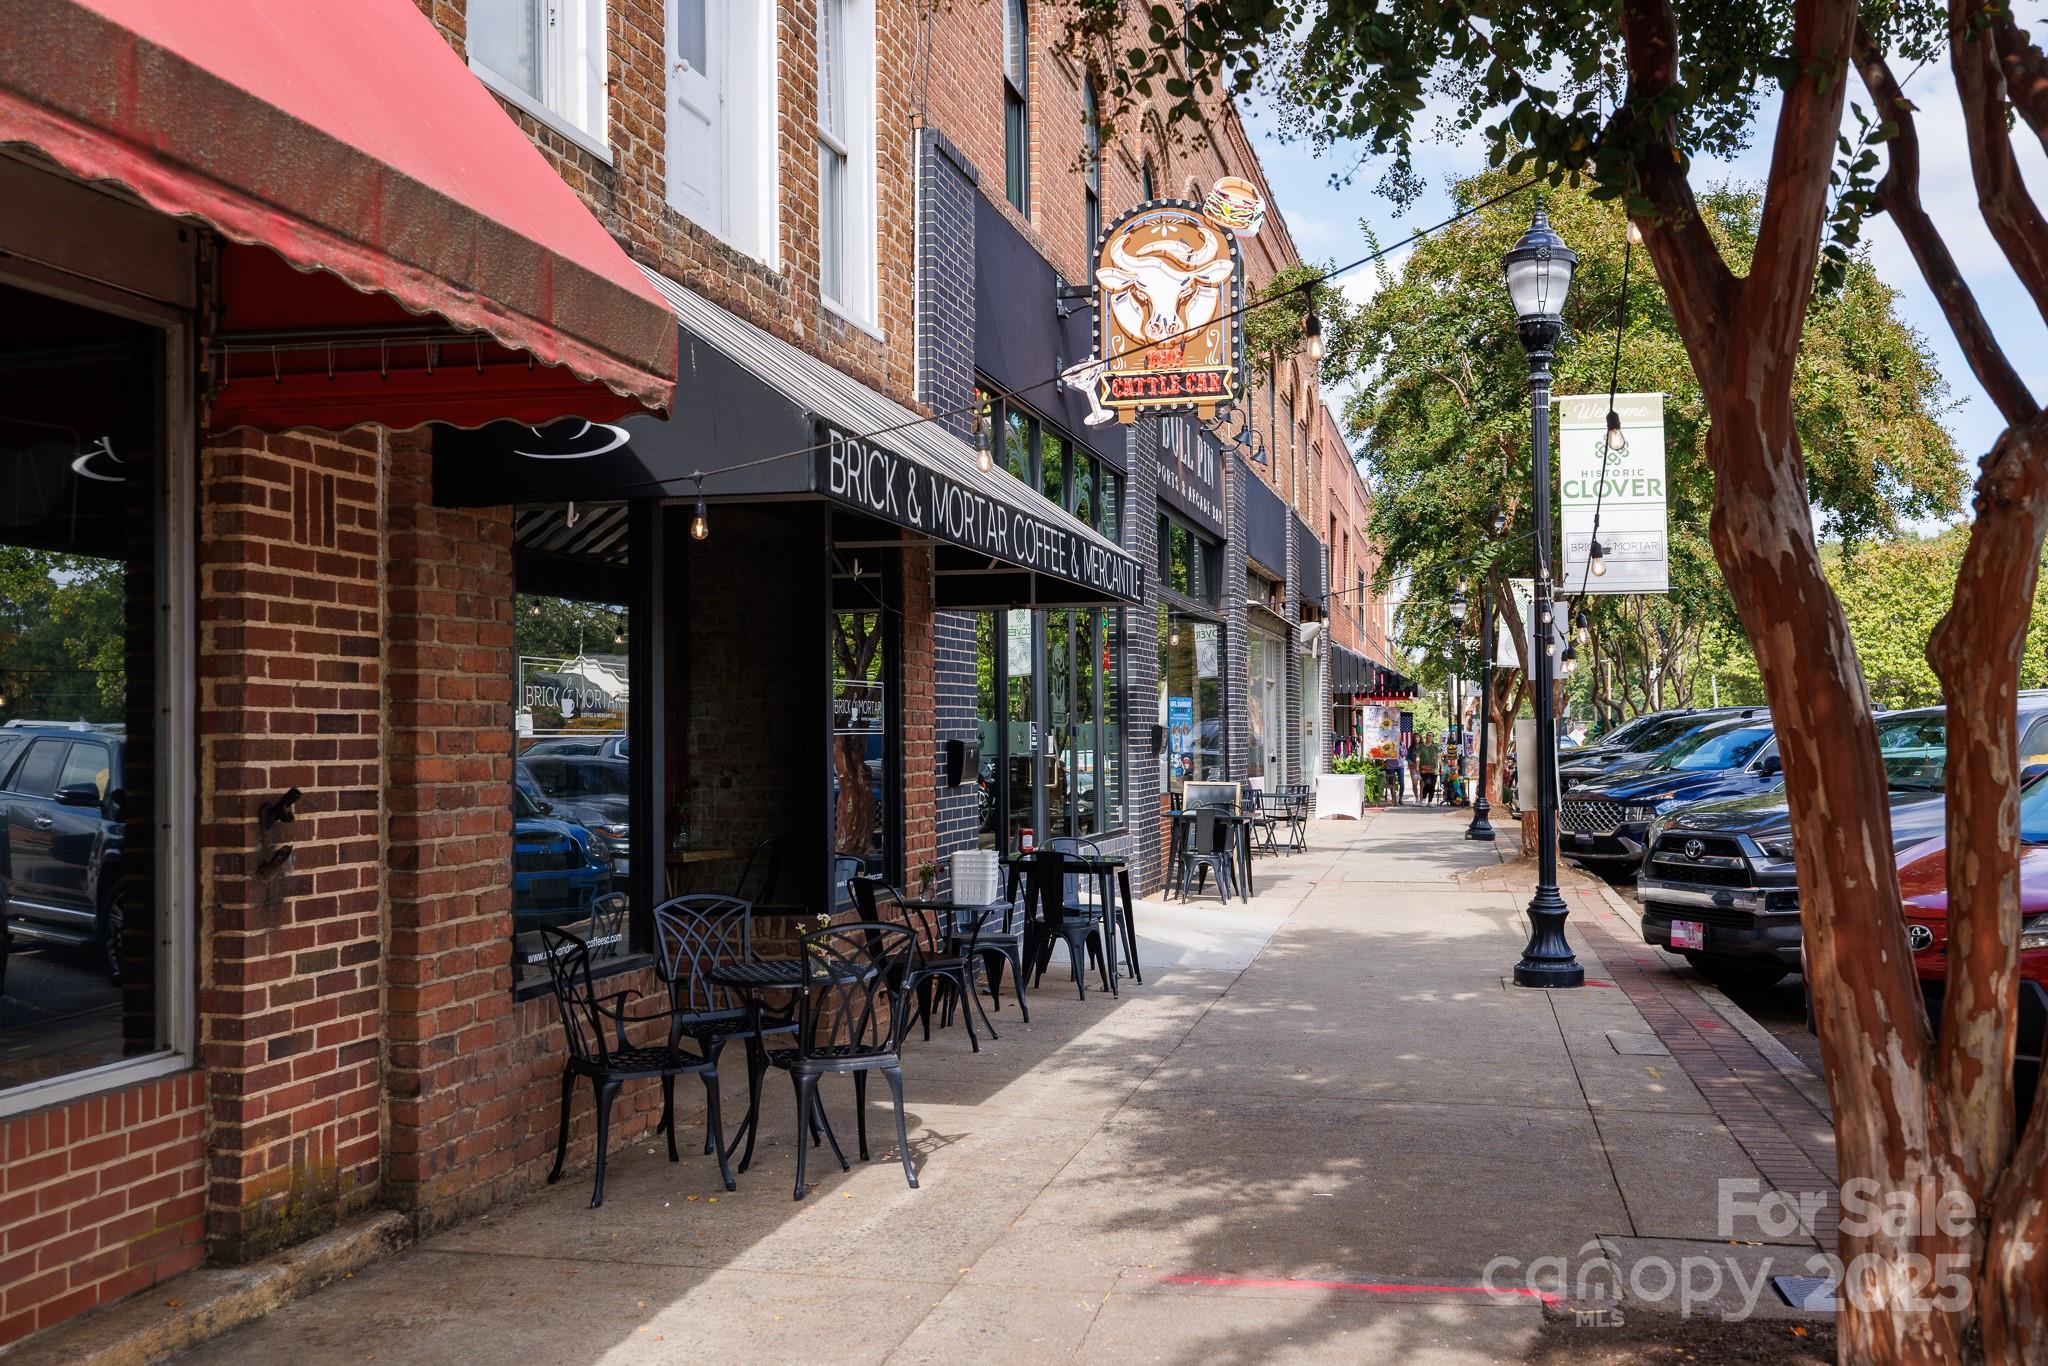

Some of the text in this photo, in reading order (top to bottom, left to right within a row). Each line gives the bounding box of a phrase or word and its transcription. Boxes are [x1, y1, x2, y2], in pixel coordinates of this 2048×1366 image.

[1111, 372, 1222, 398] CATTLE CAR
[1575, 402, 1650, 420] Weome
[1162, 417, 1214, 489] BULL PIN
[1156, 461, 1179, 492] PORTS
[1581, 468, 1645, 477] HISTORIC
[1563, 478, 1664, 499] CLOVER
[829, 428, 1142, 601] BRICK & MORTAR COFFEE & MERCANTILE
[1614, 542, 1658, 551] MORTAR
[525, 685, 560, 707] BRICK
[576, 687, 622, 712] MORTAR
[834, 699, 852, 714] BRICK
[858, 700, 881, 714] MORTAR
